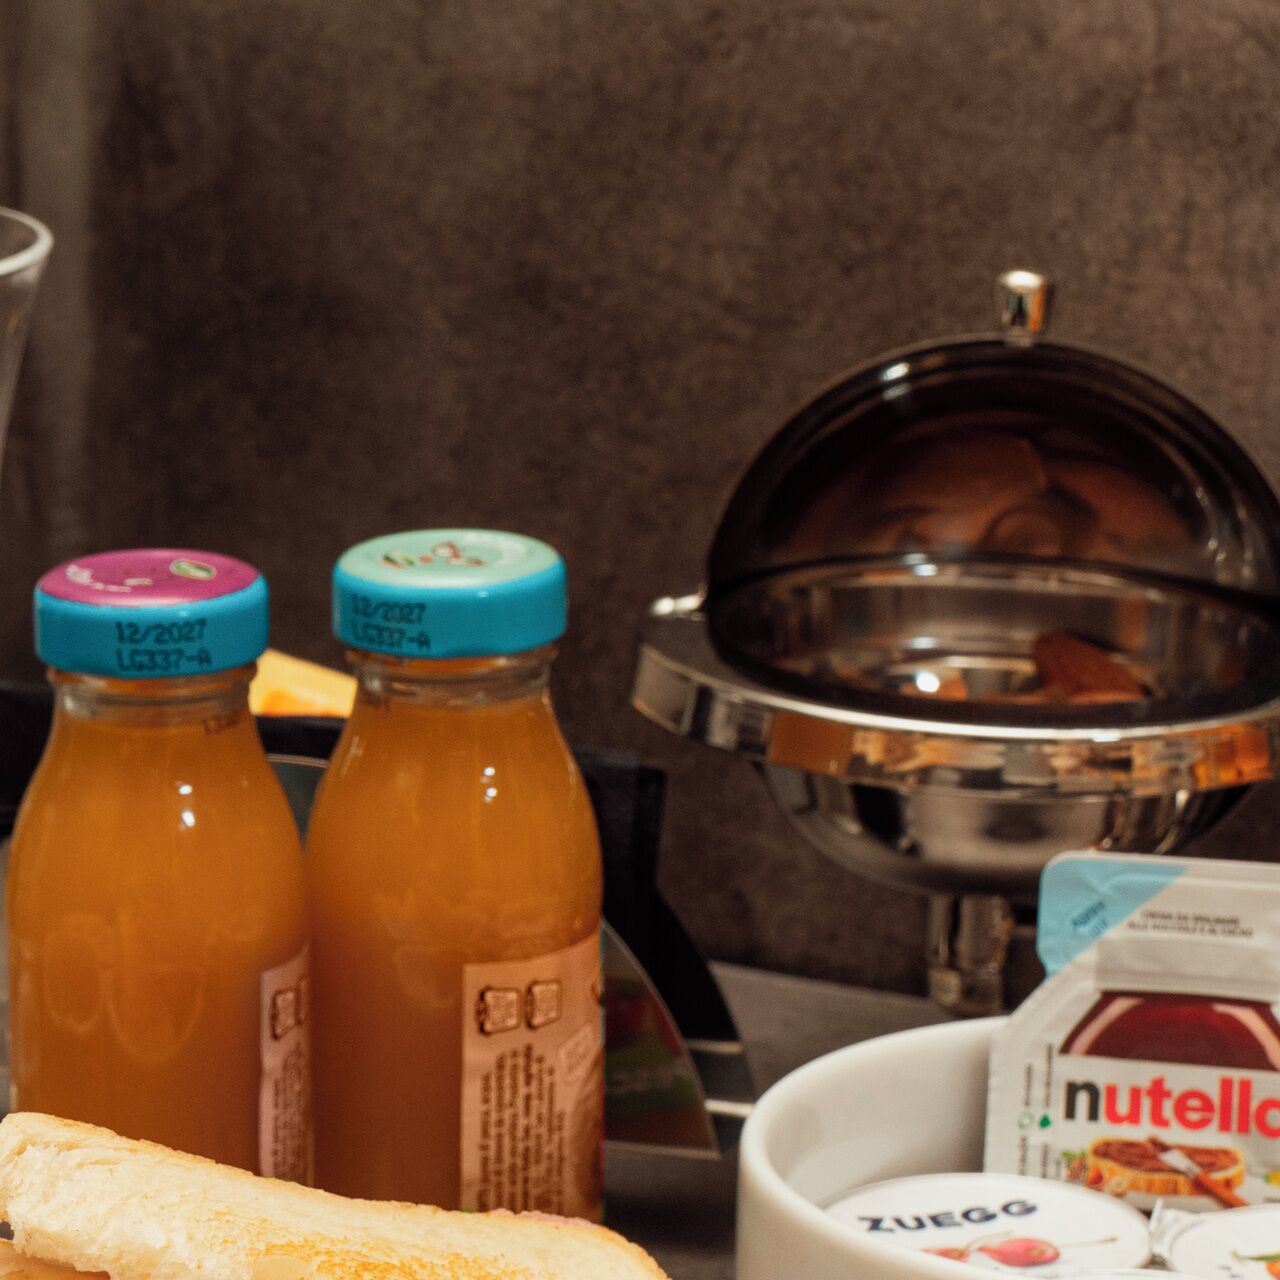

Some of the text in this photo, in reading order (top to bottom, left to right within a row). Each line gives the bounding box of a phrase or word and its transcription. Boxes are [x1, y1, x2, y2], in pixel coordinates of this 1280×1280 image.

[350, 593, 426, 624] 12/2027
[114, 618, 208, 646] 12/2027
[858, 1199, 1038, 1233] ZUEGG
